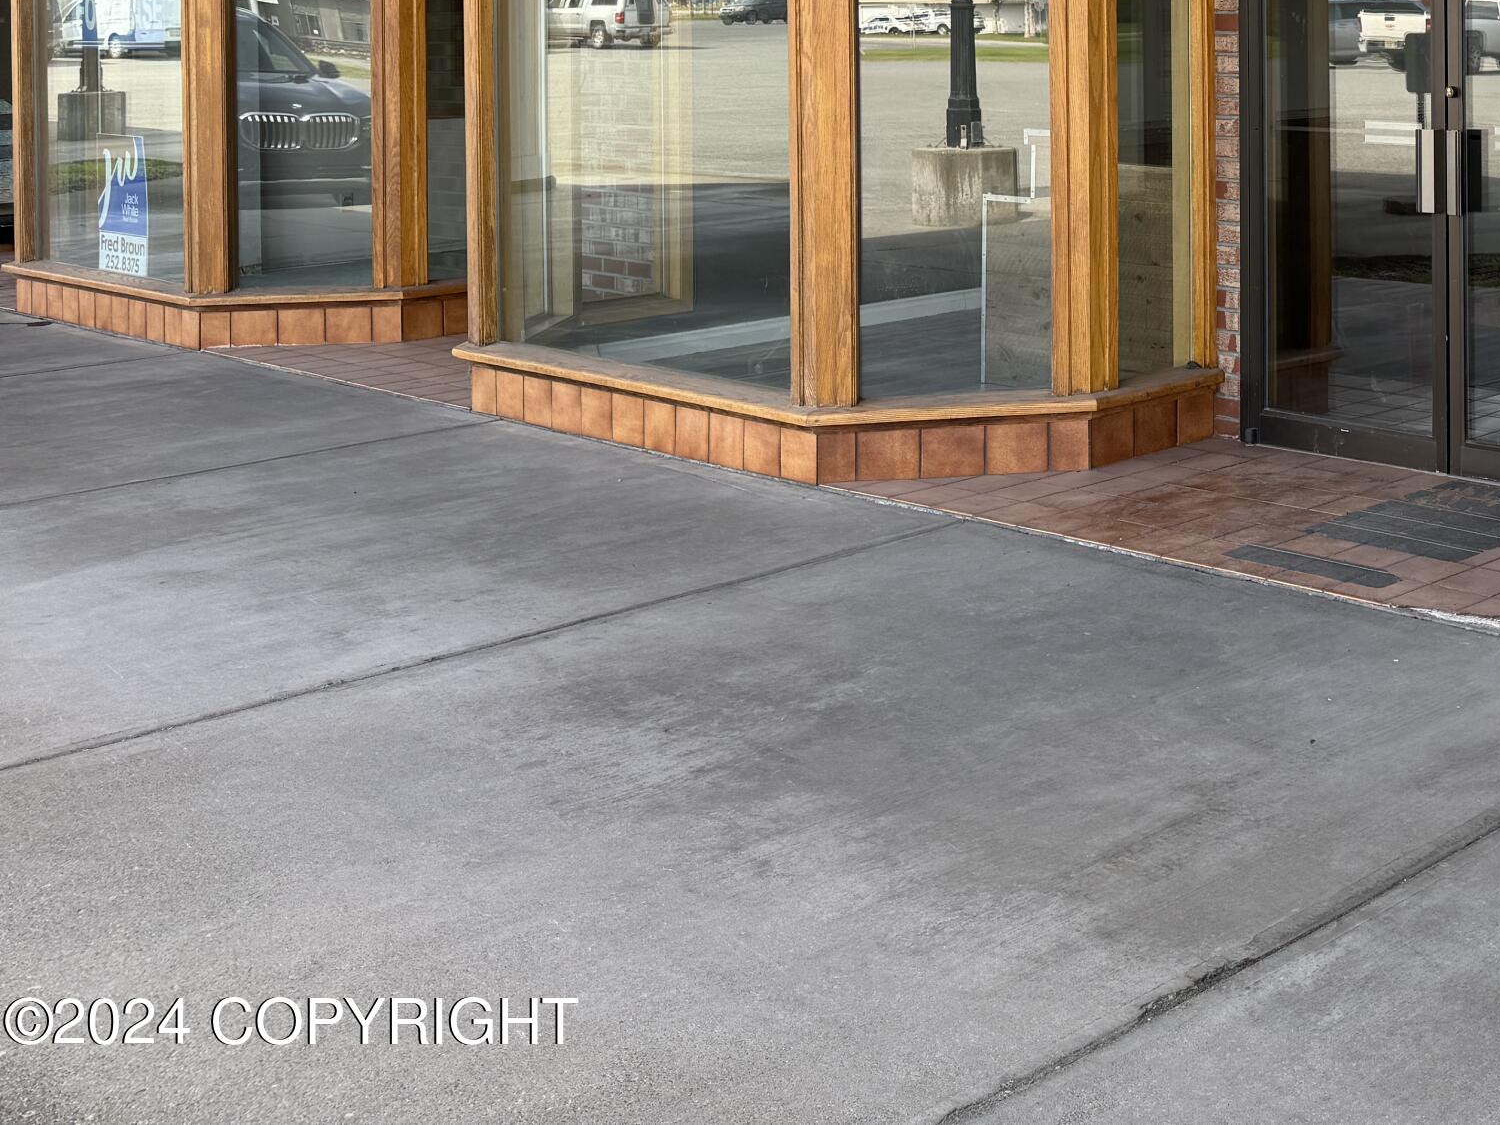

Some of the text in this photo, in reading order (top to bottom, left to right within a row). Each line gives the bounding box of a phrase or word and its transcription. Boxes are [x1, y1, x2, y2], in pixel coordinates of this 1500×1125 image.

[124, 192, 139, 205] Jack
[121, 204, 139, 217] White
[101, 234, 145, 256] Fred Braun
[105, 254, 140, 273] 252.8375
